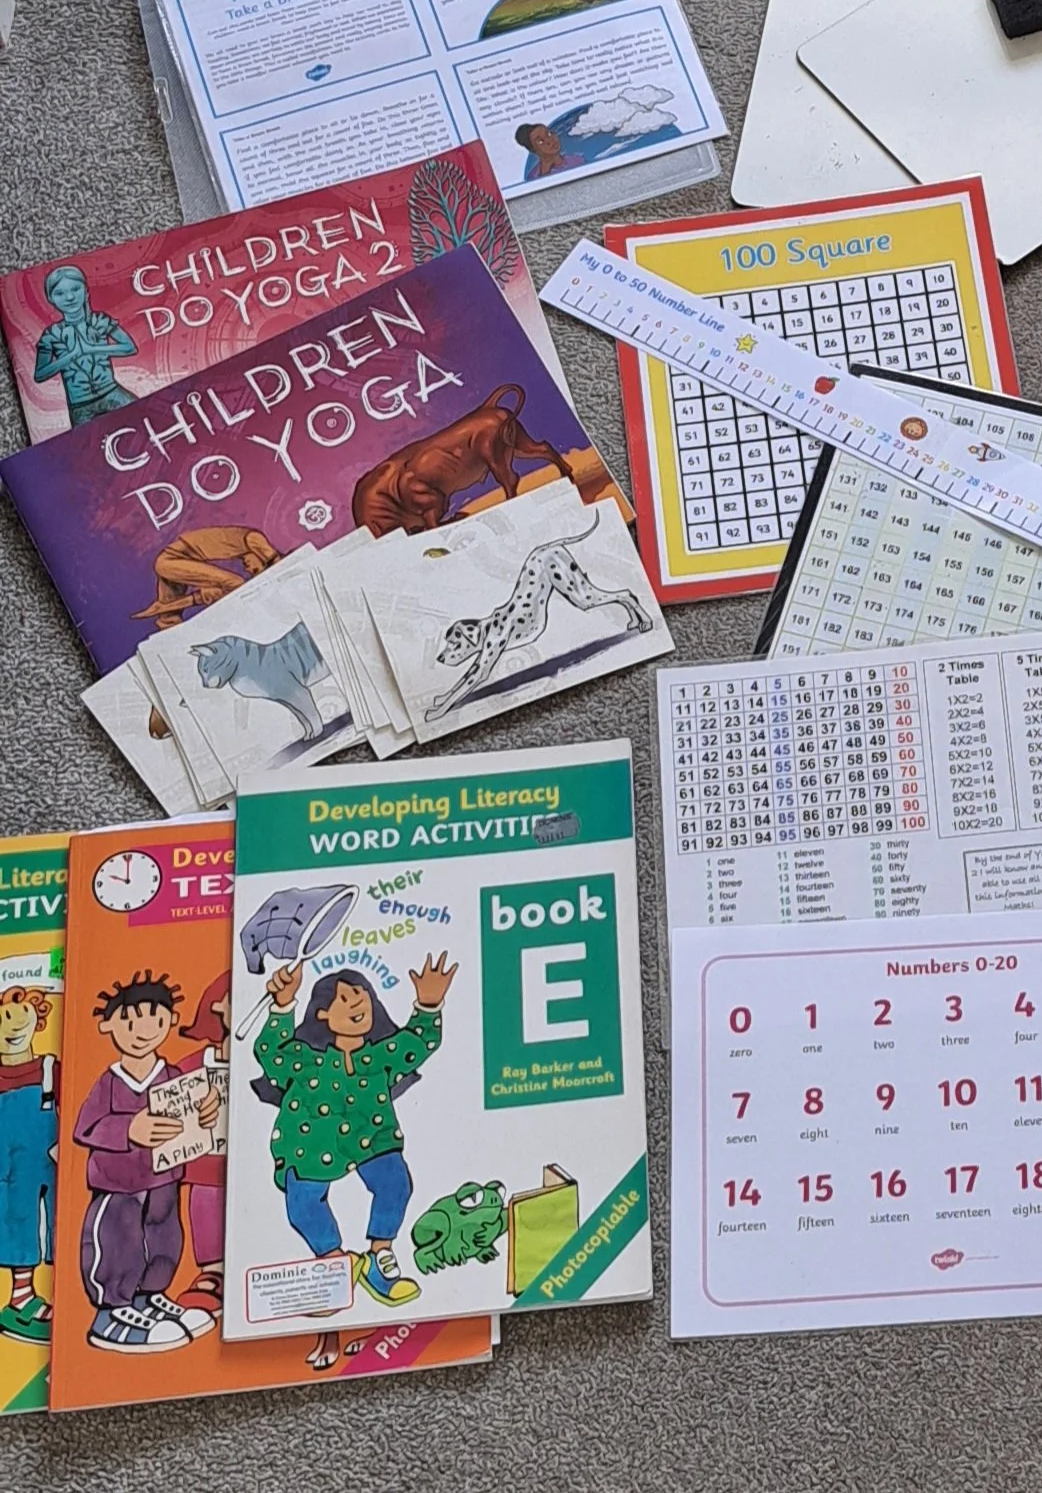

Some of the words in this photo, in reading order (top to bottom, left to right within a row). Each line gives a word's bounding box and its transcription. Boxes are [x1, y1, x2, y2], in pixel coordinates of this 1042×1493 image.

[225, 3, 259, 19] Take
[264, 0, 272, 9] a
[131, 196, 388, 298] CHILDREN
[720, 243, 776, 272] 100
[786, 233, 892, 269] Square
[137, 293, 215, 341] DO
[220, 252, 369, 325] YOGA
[371, 239, 407, 280] 2
[579, 250, 601, 272] My
[602, 262, 613, 275] 0
[614, 267, 627, 284] to
[628, 275, 648, 294] 50
[647, 287, 696, 319] Number
[699, 311, 726, 333] Line
[99, 285, 429, 474] CHILDREN
[120, 451, 243, 532] DO
[246, 349, 465, 485] YOGA
[308, 794, 451, 823] Developing
[459, 782, 561, 811] Literacy
[309, 827, 401, 855] WORD
[366, 868, 424, 901] their
[378, 897, 451, 925] enough
[490, 884, 608, 932] book
[341, 917, 417, 948] leaves
[311, 948, 400, 990] laughing
[885, 957, 971, 978] Numbers
[975, 954, 1018, 974] 0-20
[517, 940, 592, 1046] E
[490, 1078, 548, 1097] Christine
[551, 1071, 616, 1090] Moorcroft
[501, 1065, 530, 1083] Ray
[531, 1059, 575, 1075] Barker
[578, 1056, 604, 1072] and
[722, 1177, 763, 1209] 14
[797, 1173, 834, 1205] 15
[869, 1169, 908, 1201] 16
[944, 1164, 981, 1195] 17
[935, 1207, 992, 1222] seventeen
[538, 1187, 642, 1300] Photocopiable
[250, 1265, 309, 1284] Dominie
